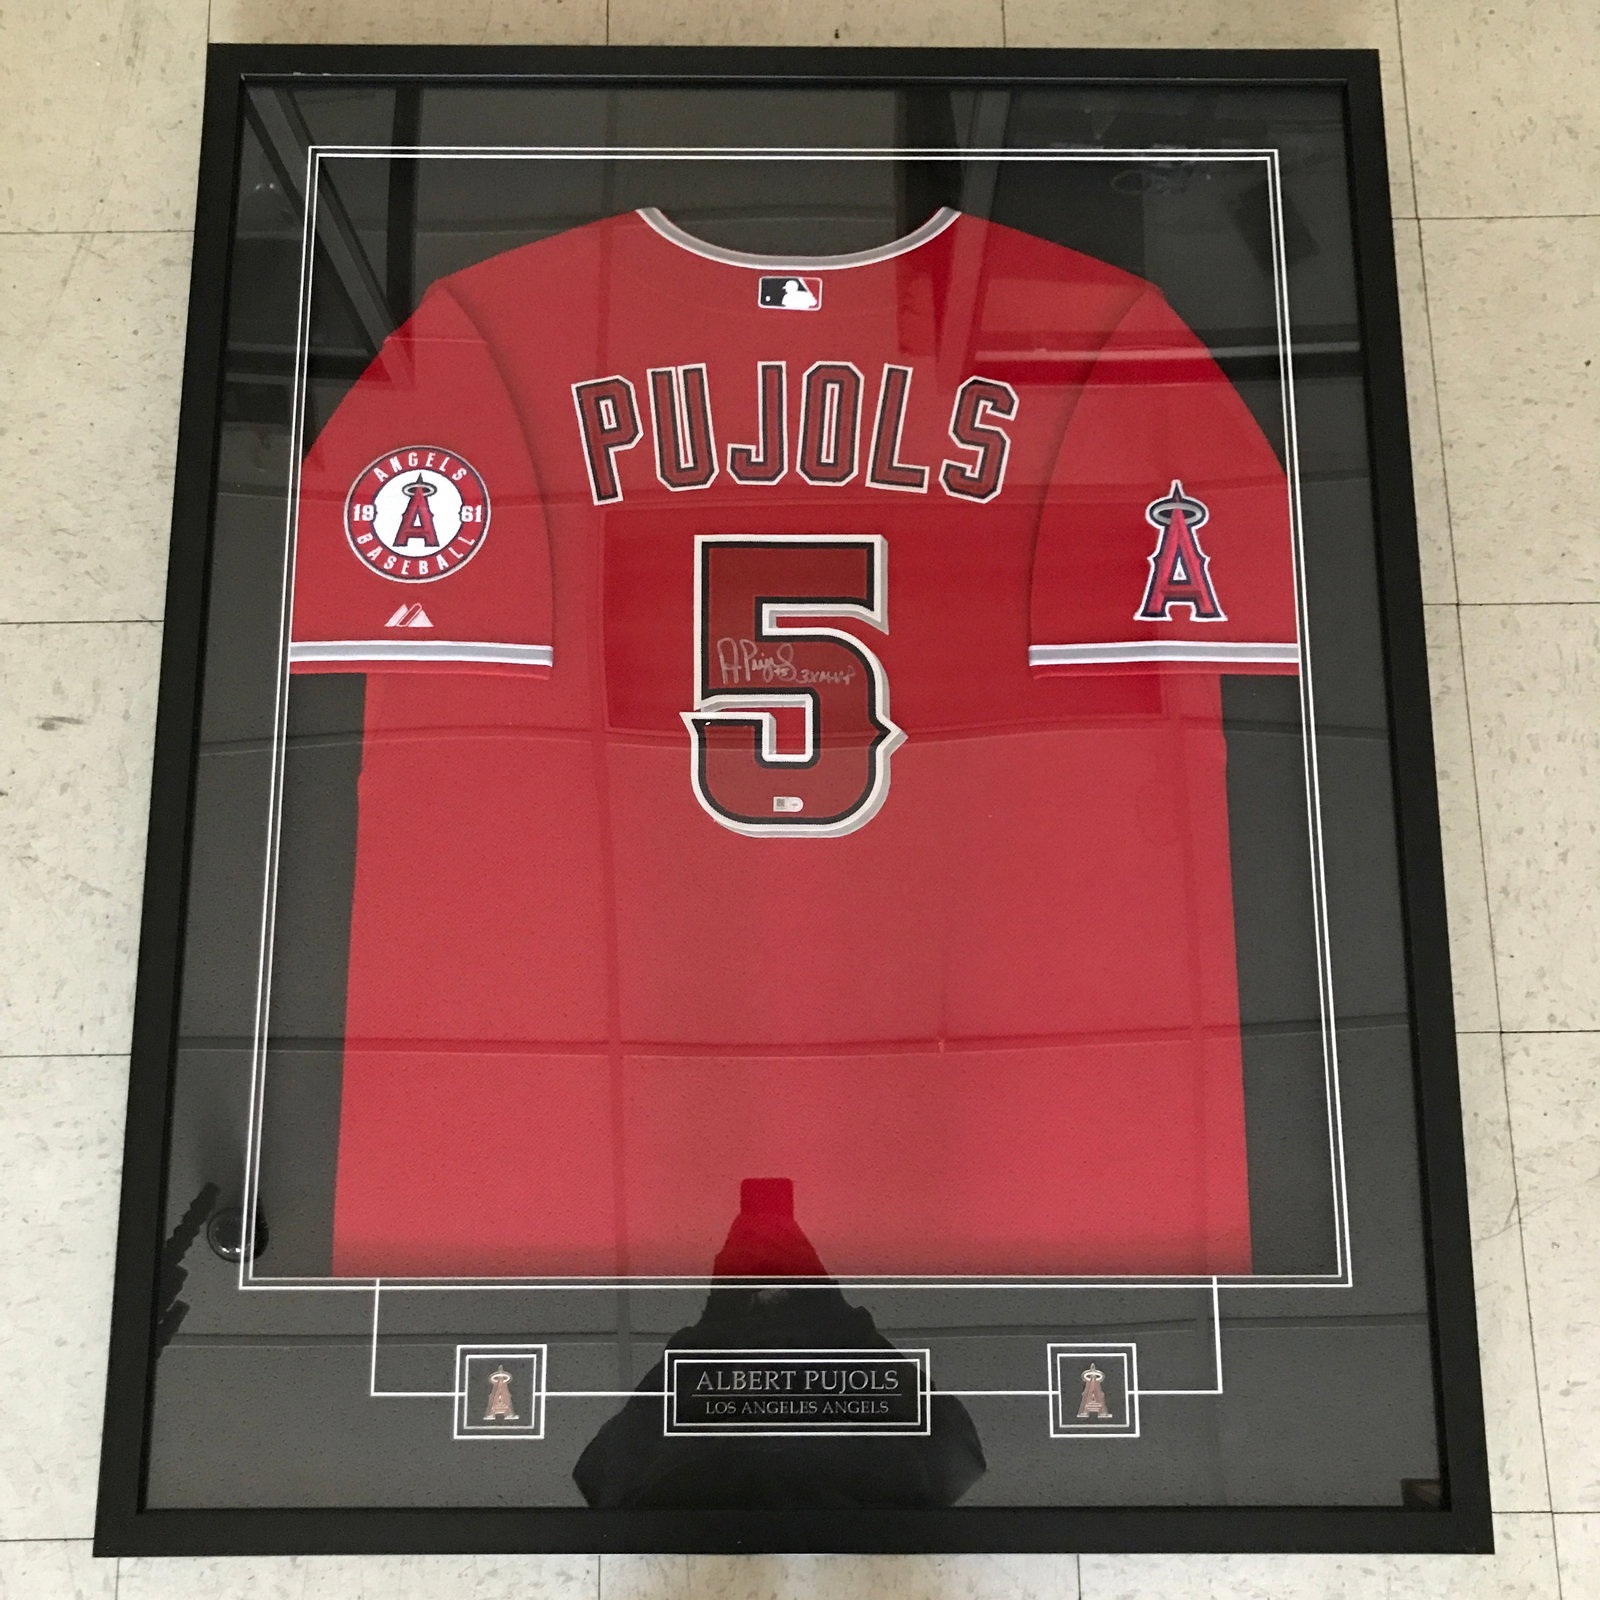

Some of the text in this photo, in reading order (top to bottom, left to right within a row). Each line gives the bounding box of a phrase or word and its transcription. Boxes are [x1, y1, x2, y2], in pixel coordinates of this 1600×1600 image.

[571, 360, 1019, 505] PUJOLS
[373, 452, 467, 482] ANGELS
[353, 503, 375, 522] 19
[461, 504, 482, 523] 61
[356, 532, 475, 575] BASEBALL
[679, 534, 908, 838] 5
[696, 1370, 899, 1394] ALBERT PUJOLS
[705, 1401, 889, 1414] LOS ANGELES ANGELS
